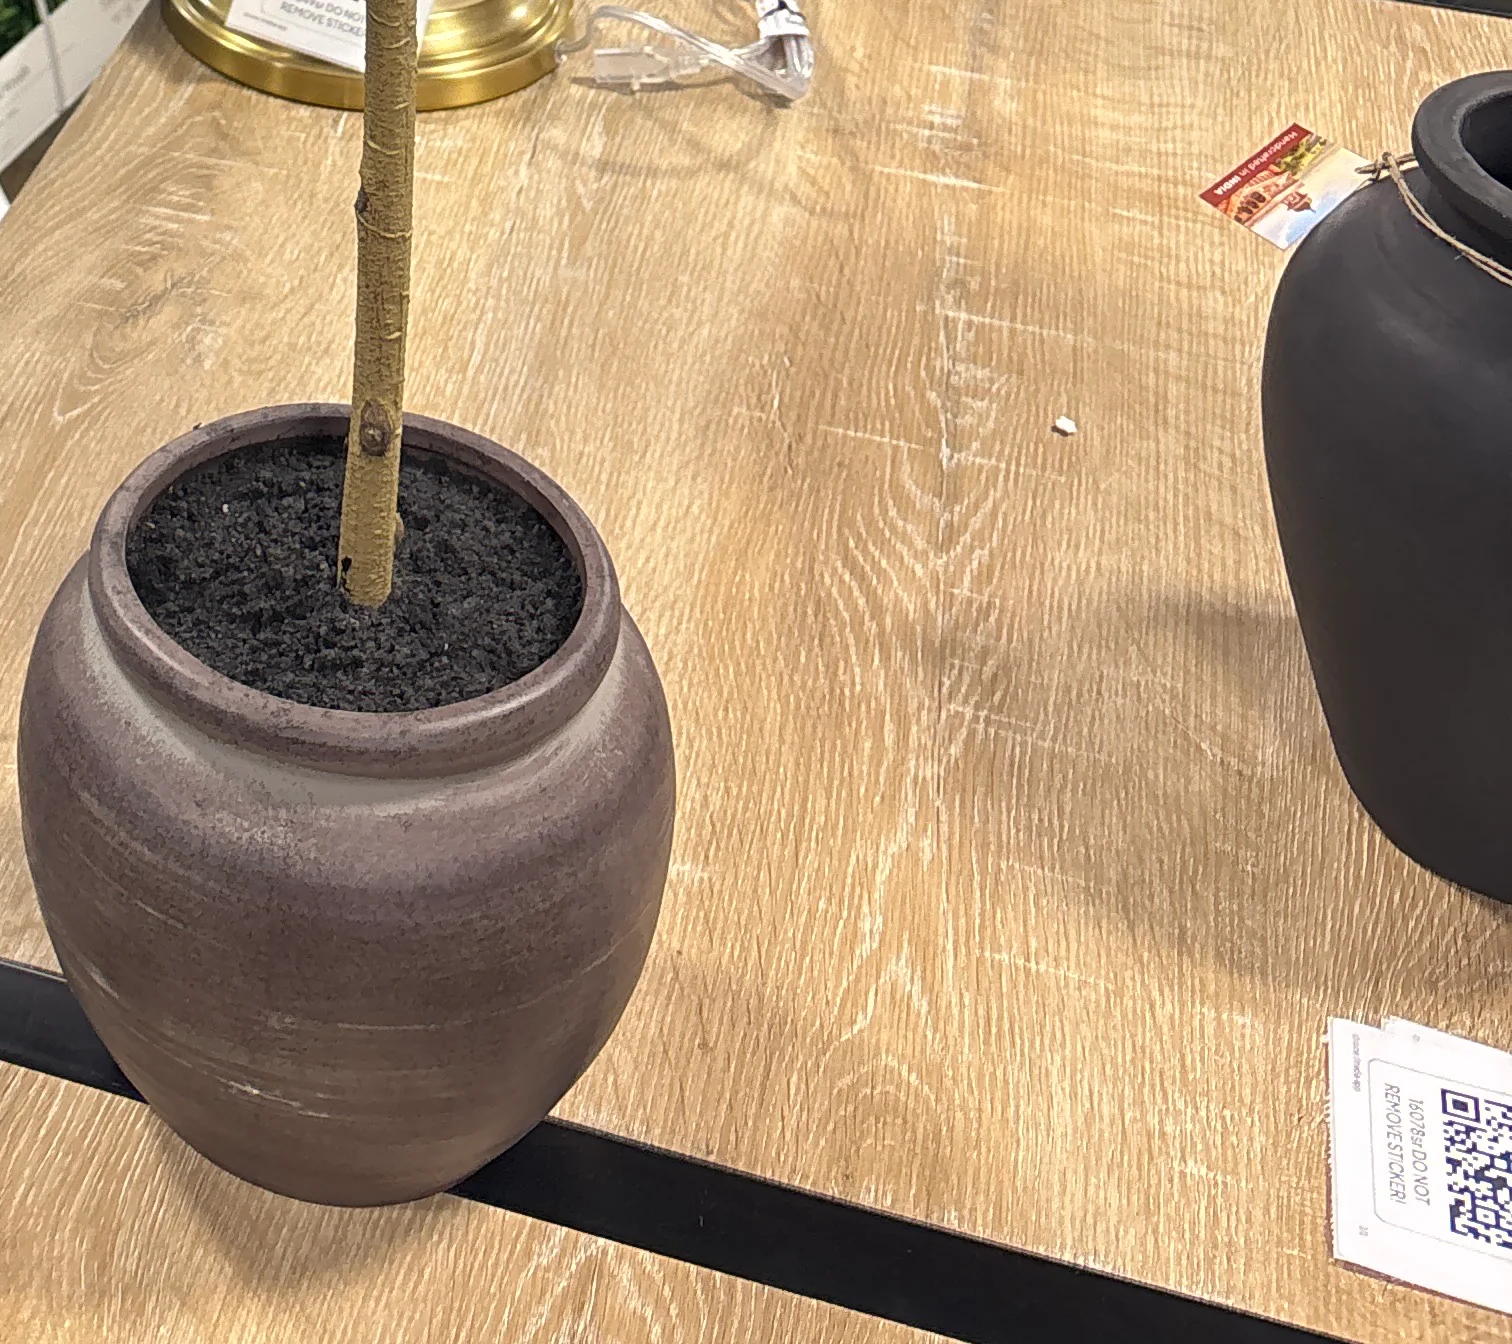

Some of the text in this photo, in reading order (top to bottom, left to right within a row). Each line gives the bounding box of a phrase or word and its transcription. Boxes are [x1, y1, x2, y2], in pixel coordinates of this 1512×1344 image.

[280, 1, 326, 24] REMOVE
[325, 3, 343, 15] DO
[1248, 131, 1298, 170] Handcrafted
[1213, 174, 1242, 195] INDIA
[1384, 1082, 1407, 1204] REMOVE STICKER!
[1411, 1149, 1428, 1173] DO
[1413, 1174, 1431, 1206] NOT
